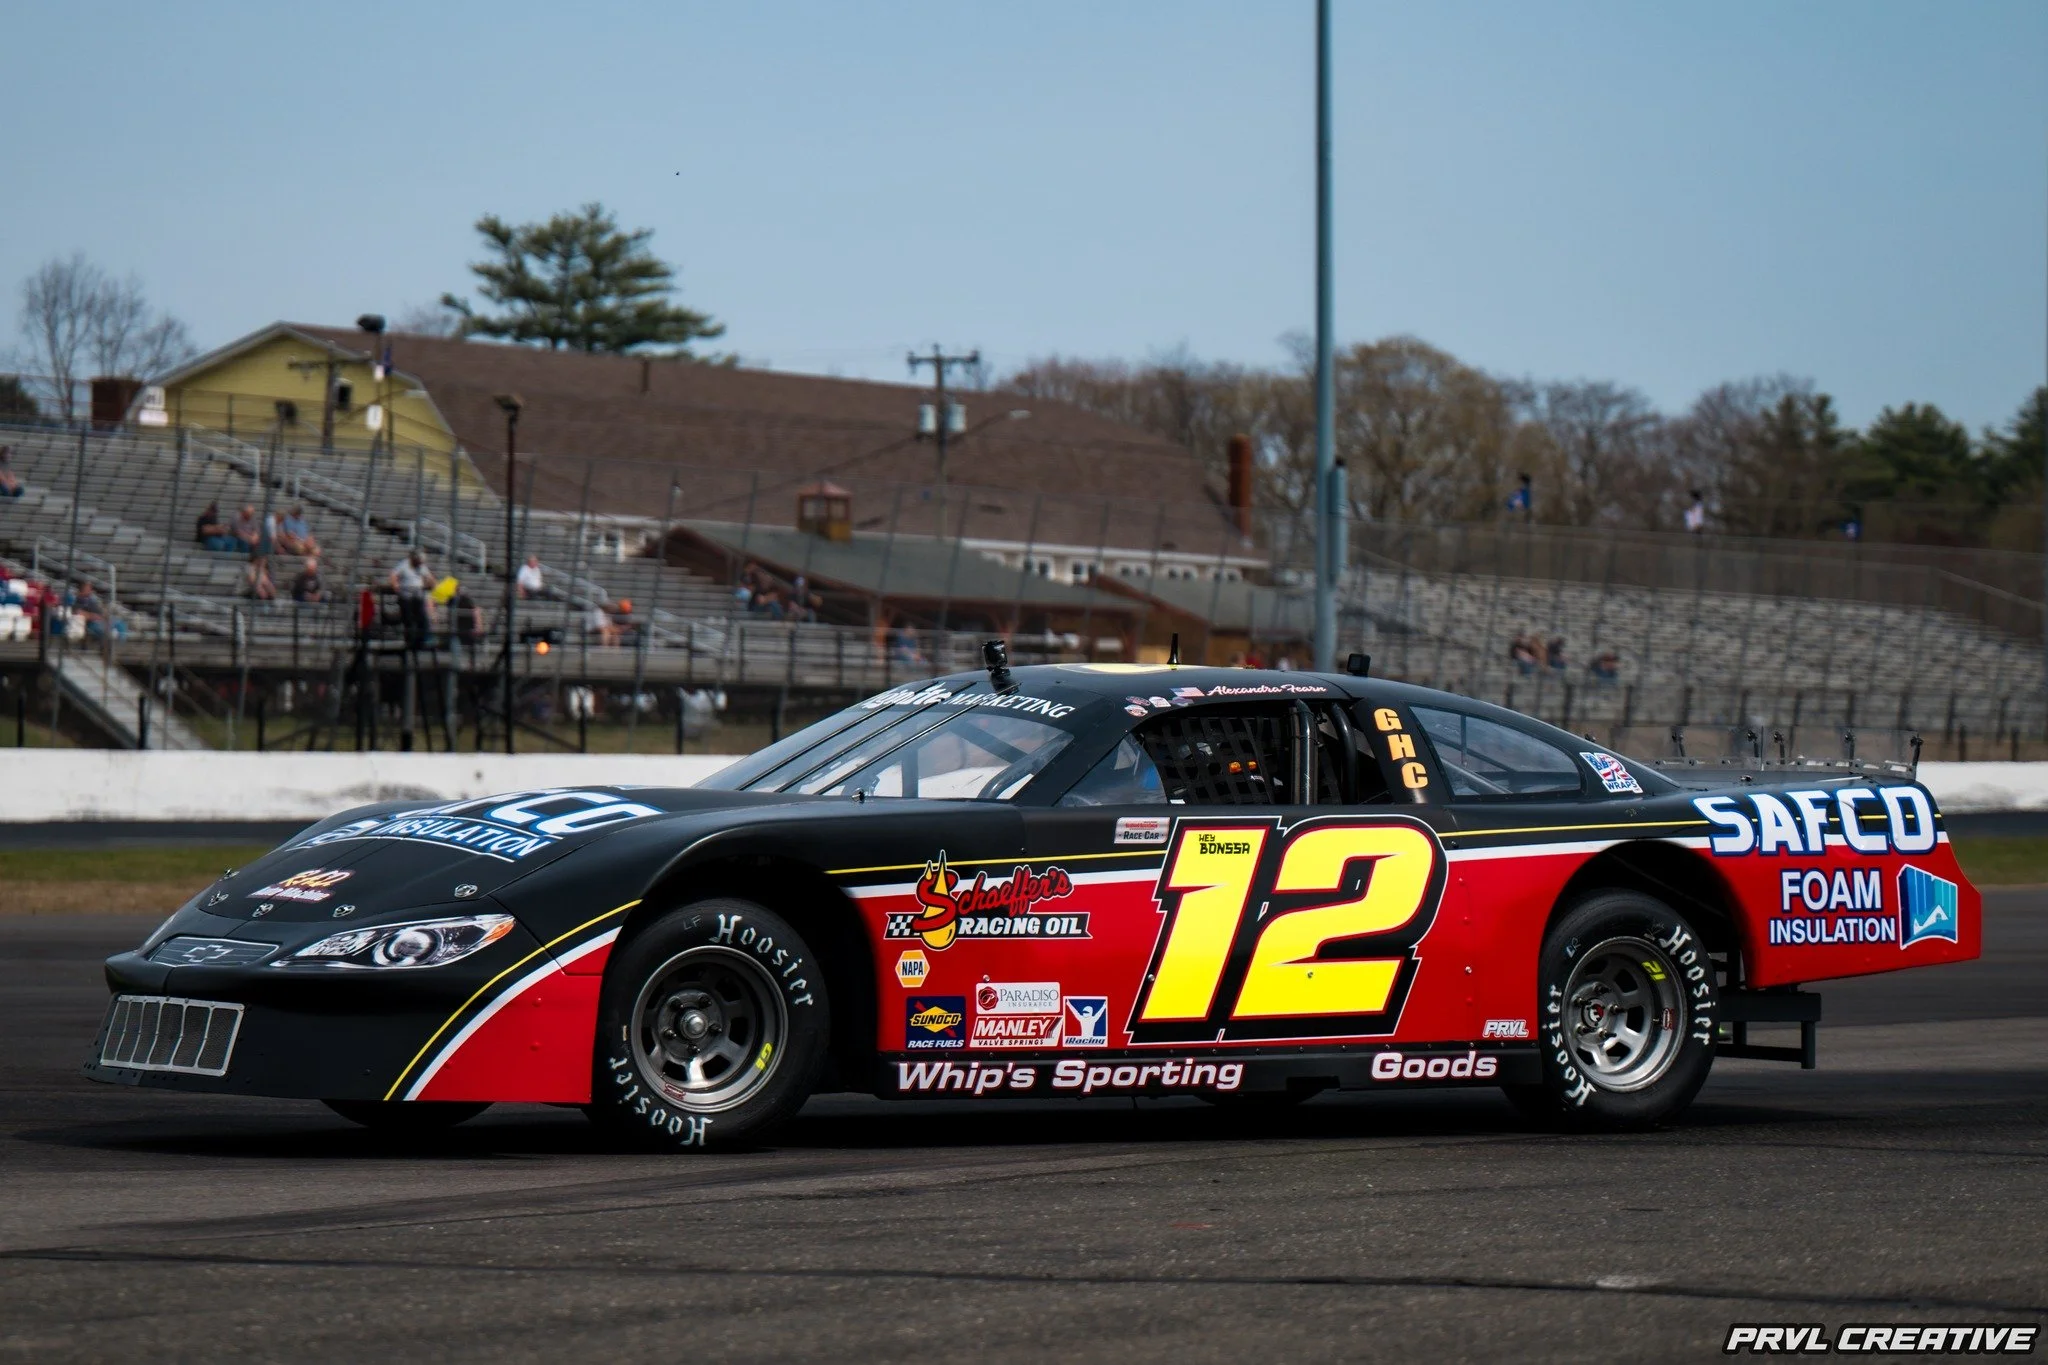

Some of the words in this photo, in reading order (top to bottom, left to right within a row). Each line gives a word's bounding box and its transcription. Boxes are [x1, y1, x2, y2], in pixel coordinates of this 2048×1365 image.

[1207, 684, 1282, 696] Alexandra
[1281, 683, 1327, 694] Fearn
[943, 693, 1075, 718] MARKETING
[1606, 781, 1638, 790] WRAPS
[1692, 786, 1936, 853] SAFCO
[371, 819, 551, 857] INSULATION
[1123, 831, 1143, 840] RACE
[1144, 831, 1159, 840] CAR
[912, 866, 1072, 931] Schaeffer's
[1780, 870, 1882, 911] FOAM
[958, 917, 1041, 935] RACING
[1045, 917, 1082, 935] OIL
[1138, 825, 1434, 1022] 12
[1770, 917, 1896, 944] INSULATION
[709, 913, 814, 1006] Hoosier
[901, 961, 924, 976] NAPA
[1000, 988, 1059, 1002] PARADISO
[1659, 925, 1717, 1046] Hoosier
[912, 1014, 960, 1025] SUNOCO
[975, 1019, 1051, 1037] MANLEY
[1483, 1021, 1529, 1037] PRVL
[907, 1040, 935, 1048] RACE
[936, 1039, 964, 1048] FUELS
[1065, 1037, 1106, 1046] iRacing
[1541, 984, 1597, 1106] Hoosier
[898, 1062, 1035, 1095] Whip's
[1053, 1058, 1244, 1093] Sporting
[1371, 1051, 1498, 1079] Goods
[609, 1056, 714, 1146] Hoosier
